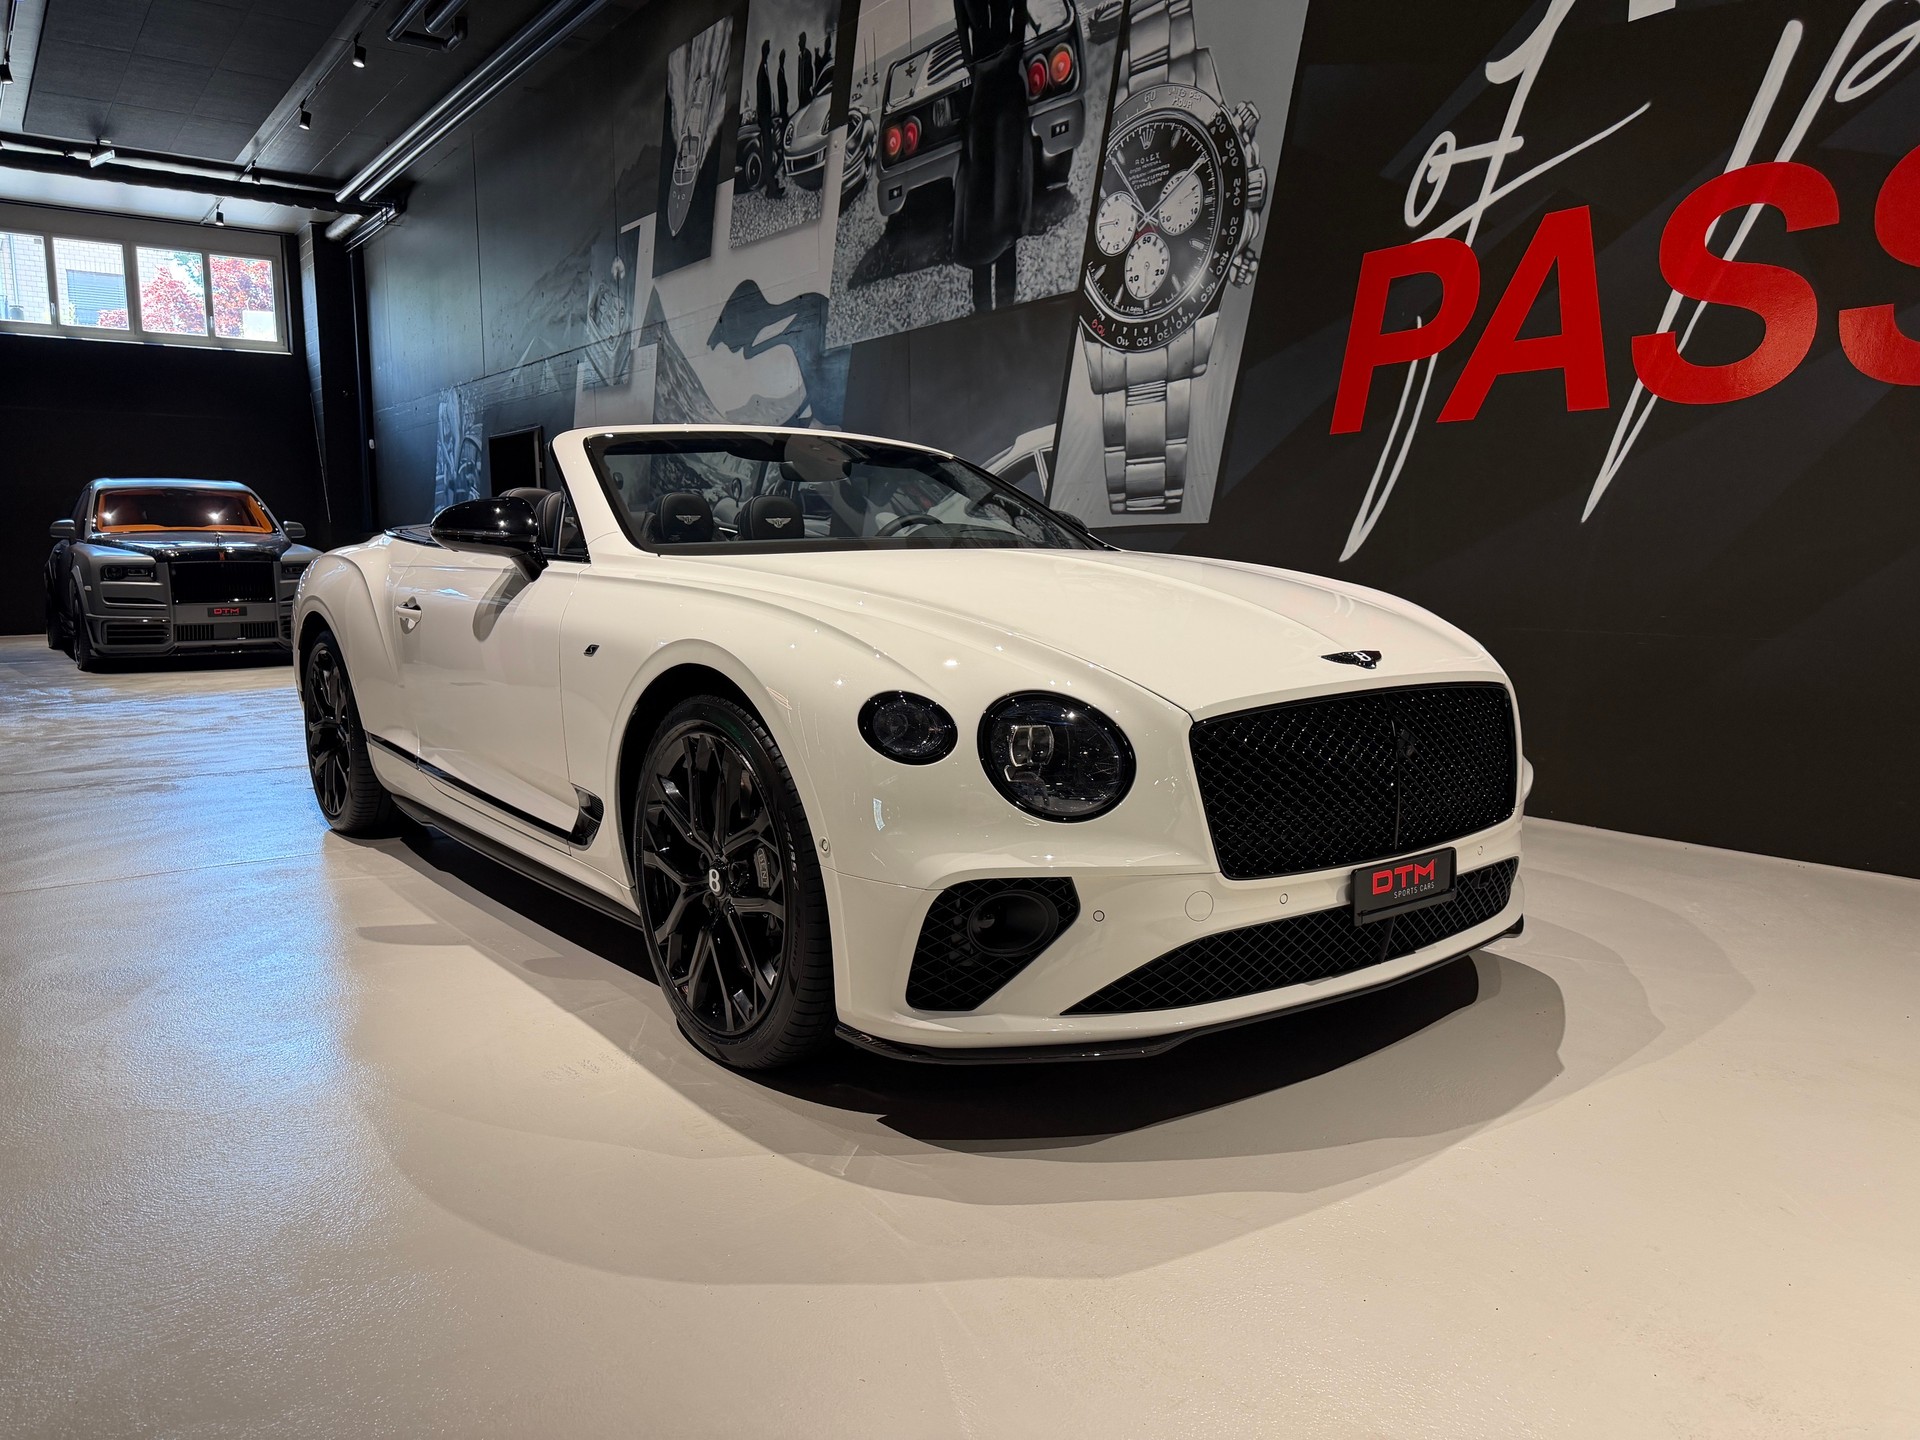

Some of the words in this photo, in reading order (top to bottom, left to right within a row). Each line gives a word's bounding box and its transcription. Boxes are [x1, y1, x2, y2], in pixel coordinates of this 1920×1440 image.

[1225, 138, 1239, 167] 300
[1233, 177, 1242, 206] 240
[1227, 216, 1239, 245] 200
[213, 607, 240, 615] DTM
[708, 868, 721, 892] B
[1372, 859, 1435, 896] DTM
[1393, 887, 1418, 899] SPORTS
[1420, 881, 1435, 892] CARS
